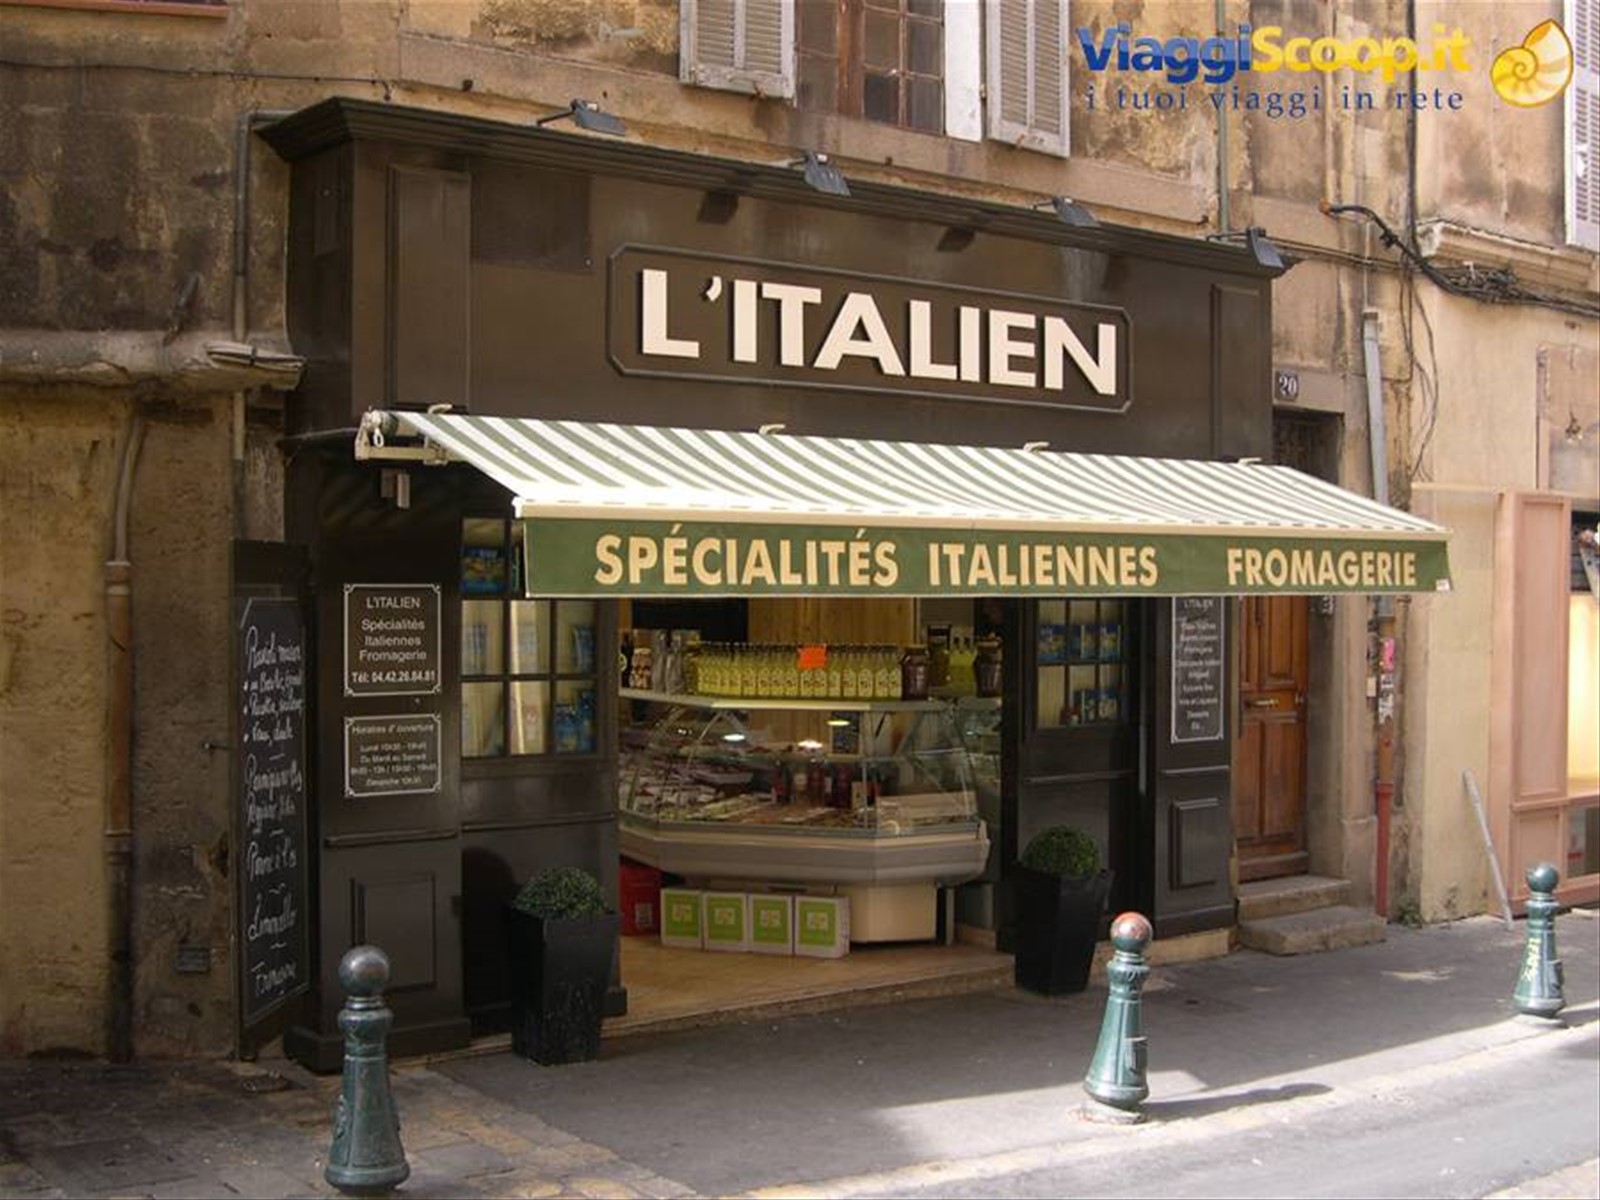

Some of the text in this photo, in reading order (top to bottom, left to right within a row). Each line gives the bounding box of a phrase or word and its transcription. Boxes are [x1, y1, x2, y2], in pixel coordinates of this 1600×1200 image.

[641, 268, 1117, 396] L'ITALIEN
[1279, 375, 1297, 396] 20
[594, 523, 1417, 587] SPÉCIALITÉS ITALIENNES FROMAGERIE
[366, 596, 421, 609] L'ITALIEN
[361, 618, 425, 633] Spécialités
[364, 635, 422, 647] Italiennes
[359, 649, 428, 663] Fromagerie
